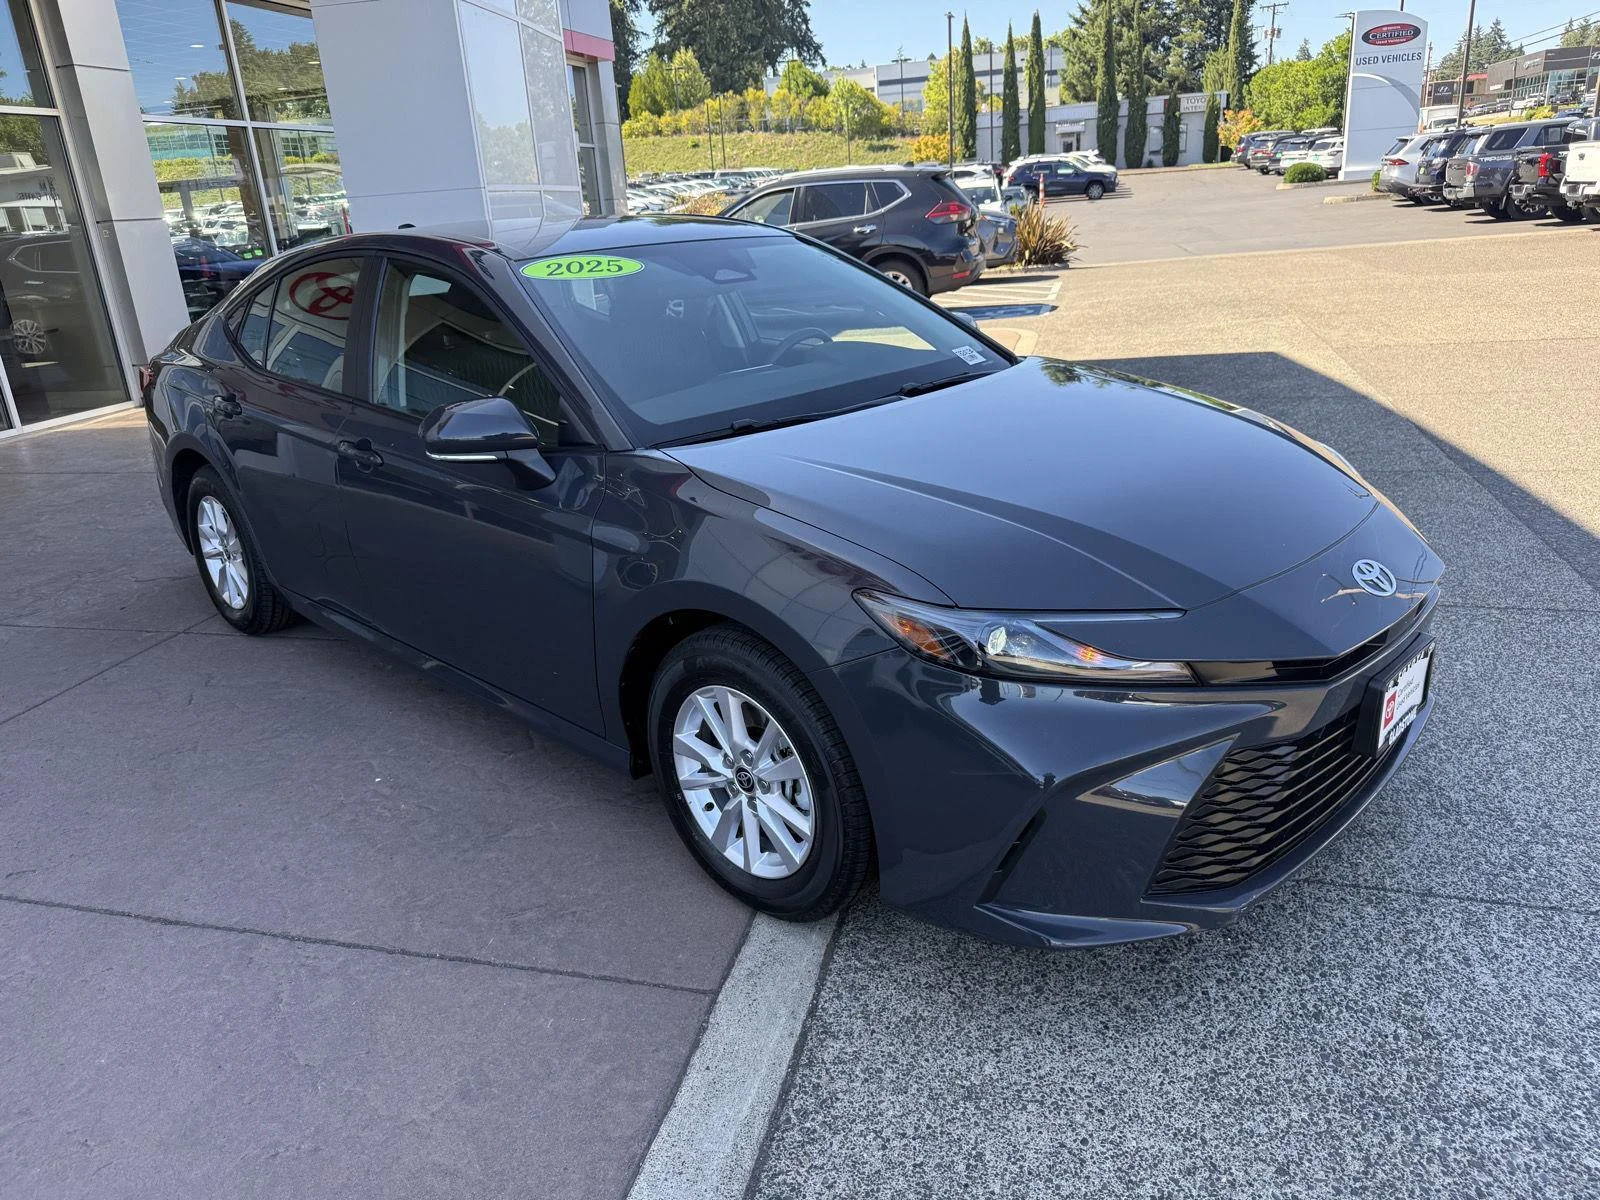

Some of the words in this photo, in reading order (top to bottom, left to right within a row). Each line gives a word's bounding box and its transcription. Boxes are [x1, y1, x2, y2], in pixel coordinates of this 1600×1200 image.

[1369, 30, 1414, 40] CERTIFIED
[1355, 56, 1379, 66] USED
[1381, 52, 1422, 64] VEHICLES
[546, 259, 624, 277] 2025
